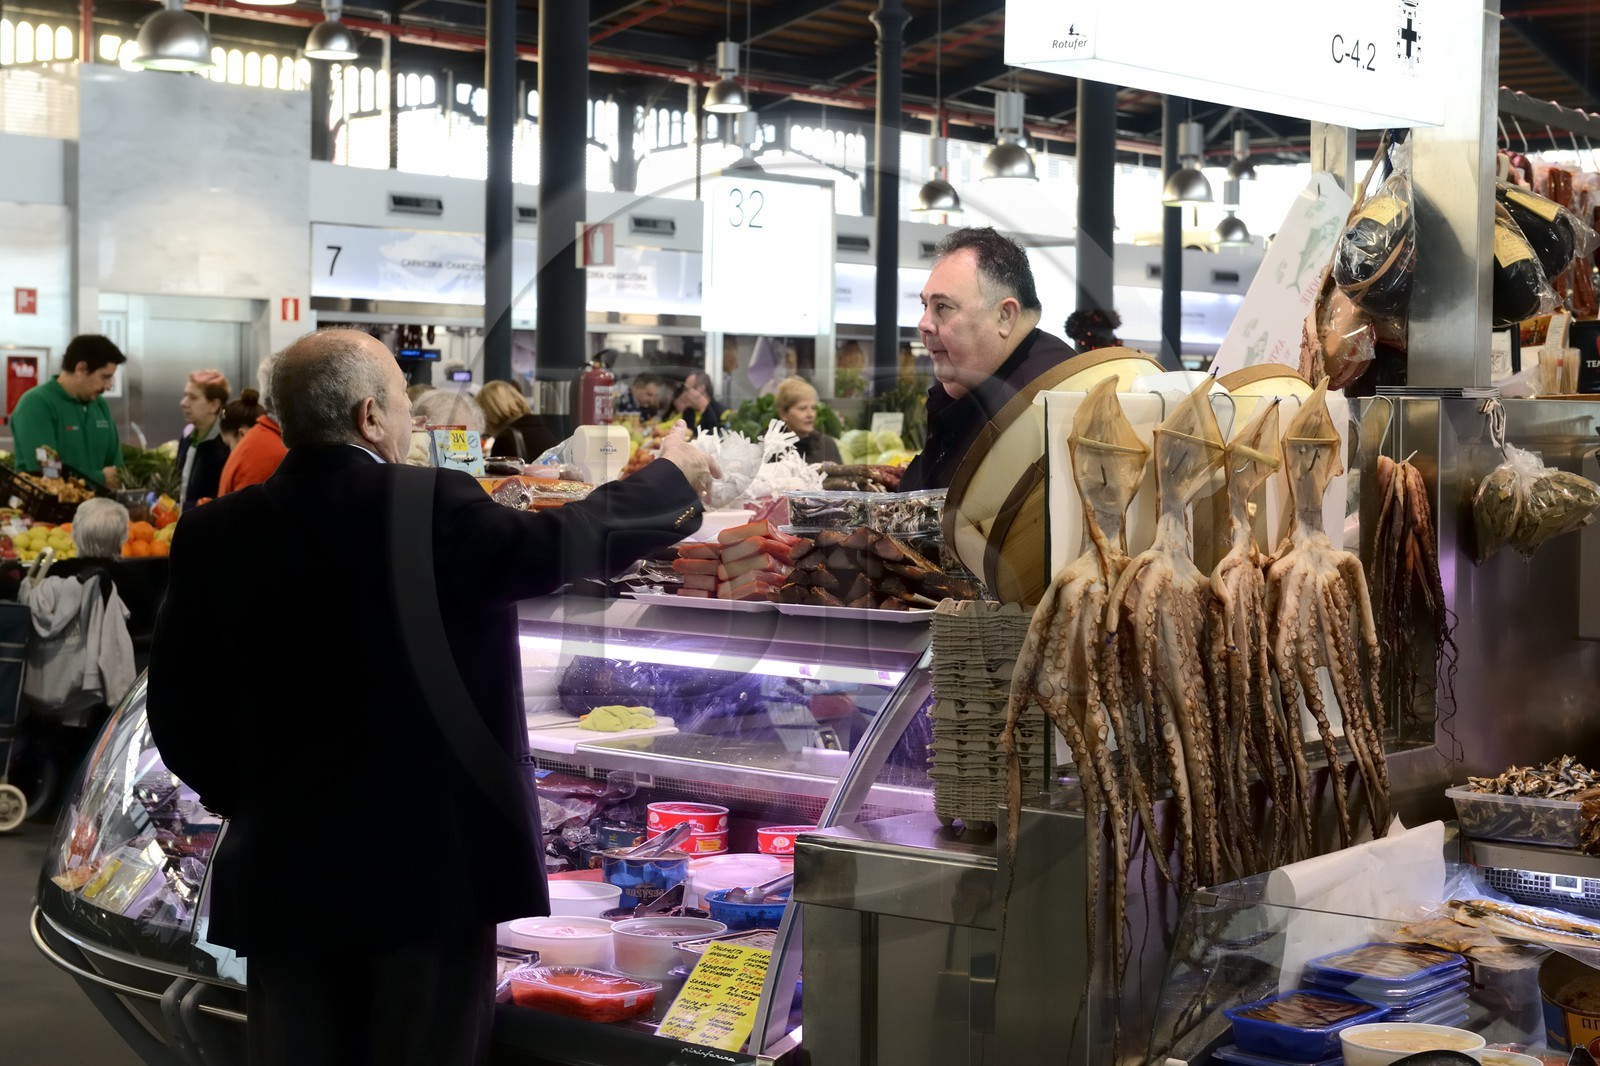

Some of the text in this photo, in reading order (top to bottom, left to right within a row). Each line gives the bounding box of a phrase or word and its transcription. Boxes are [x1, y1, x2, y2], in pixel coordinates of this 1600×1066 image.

[1052, 38, 1088, 50] Rotufer
[1331, 33, 1376, 72] C-4.2
[728, 188, 764, 228] 32
[326, 245, 342, 277] 7
